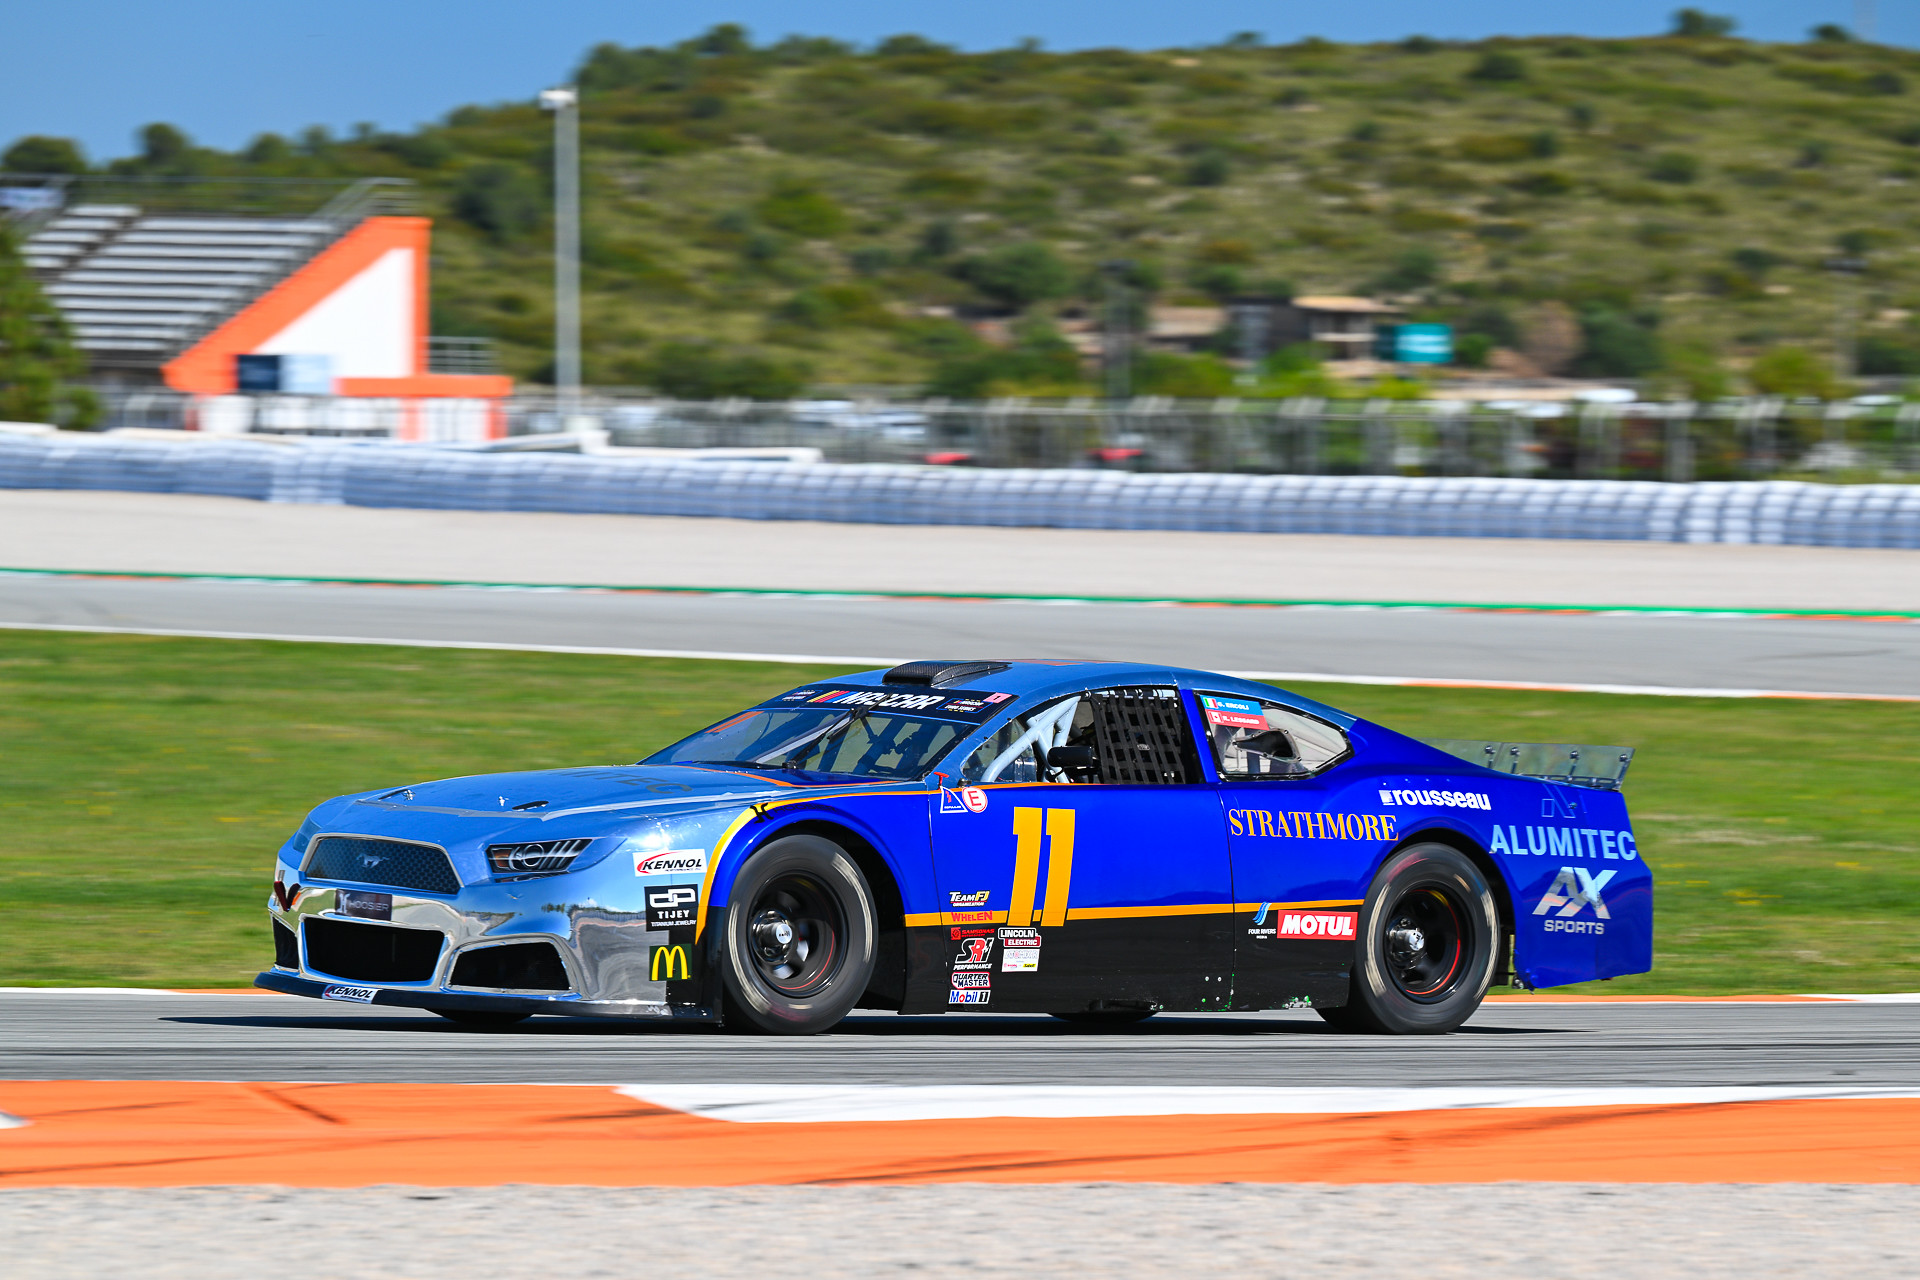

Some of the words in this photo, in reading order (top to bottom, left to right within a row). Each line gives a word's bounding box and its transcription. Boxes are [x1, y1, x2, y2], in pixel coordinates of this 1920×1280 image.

[832, 691, 946, 709] NASCAR
[967, 790, 982, 807] E
[1390, 789, 1491, 811] rousseau
[1228, 808, 1399, 842] STRATHMORE
[1489, 824, 1638, 861] ALUMITEC
[642, 858, 702, 871] KENNOL
[1007, 806, 1076, 927] 11
[1532, 866, 1618, 920] AX
[349, 900, 390, 912] HOOSIER
[657, 909, 690, 919] TIJEY
[951, 910, 993, 922] WHELEN
[1280, 914, 1354, 936] MOTUL
[1544, 919, 1605, 935] SPORTS
[1000, 929, 1035, 938] LINCOLN
[953, 973, 988, 983] QUARTER
[957, 979, 988, 988] MASTER
[330, 986, 373, 998] KENNOL
[950, 990, 978, 1003] Mobil
